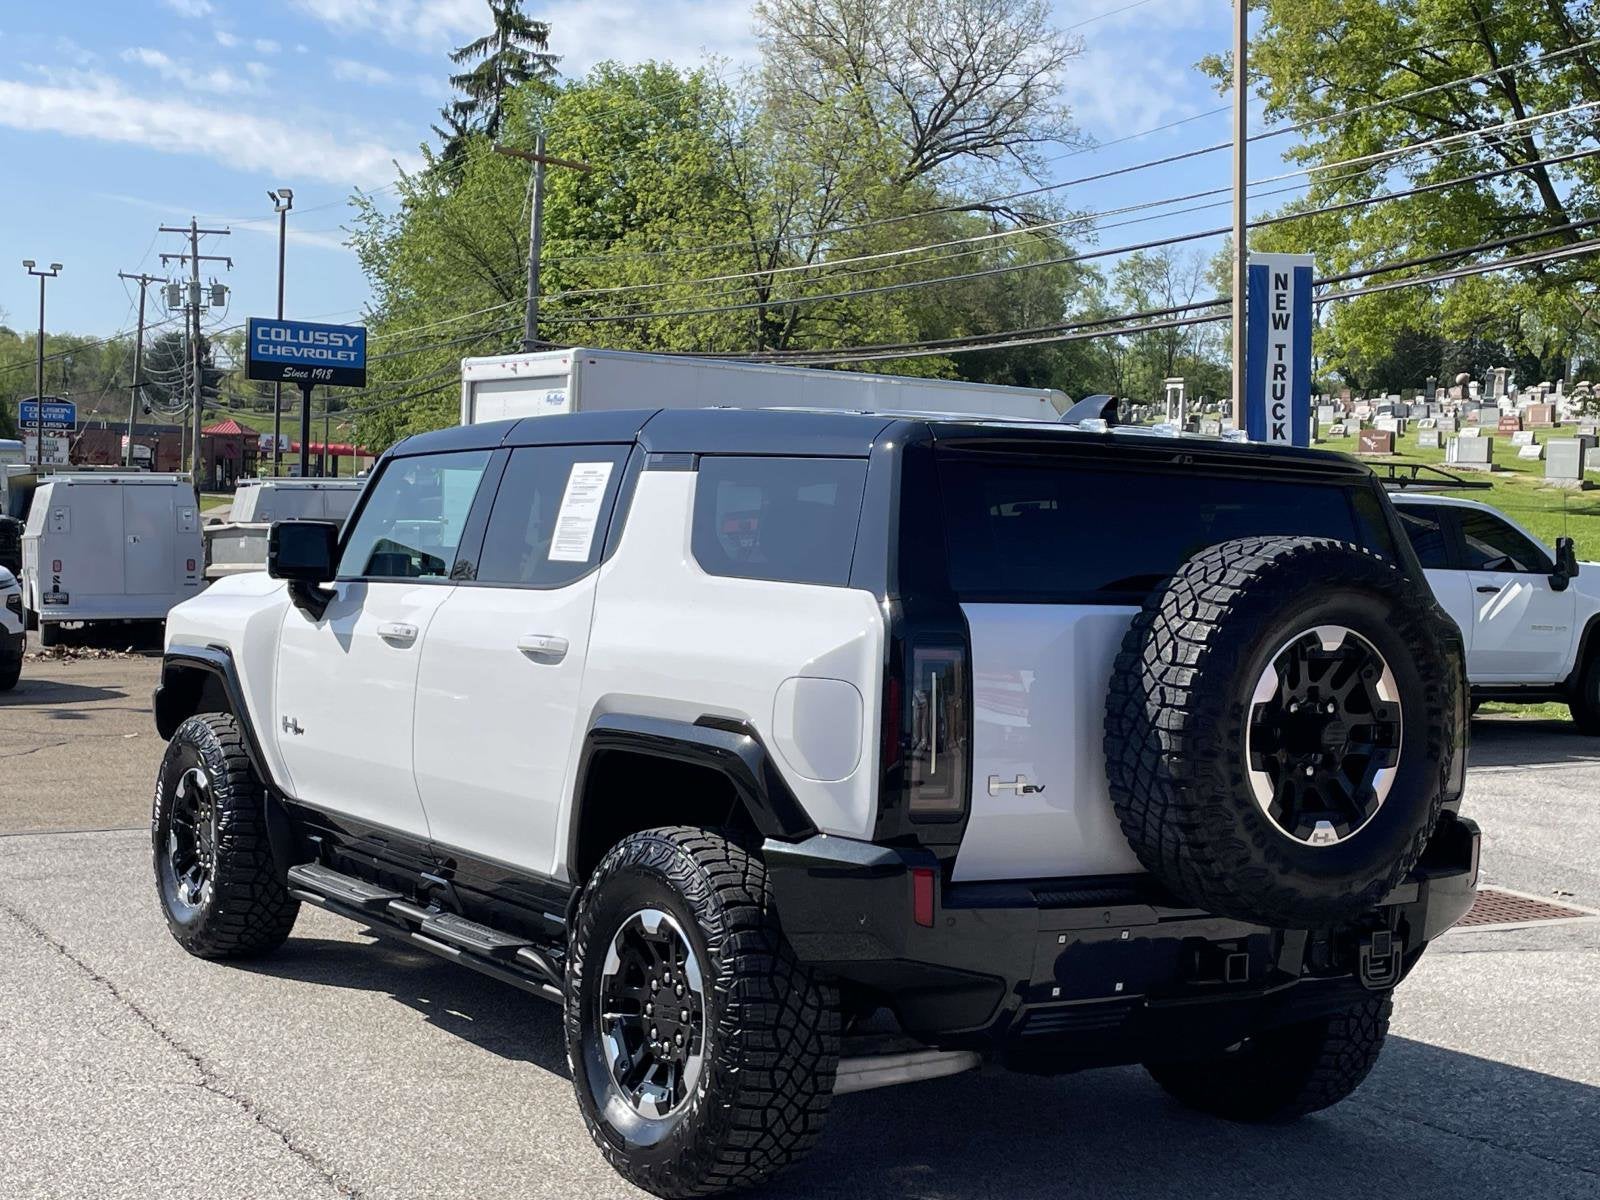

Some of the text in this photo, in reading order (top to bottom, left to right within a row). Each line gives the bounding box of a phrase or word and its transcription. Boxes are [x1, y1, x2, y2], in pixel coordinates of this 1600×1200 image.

[257, 327, 359, 348] COLUSSY
[258, 344, 358, 361] CHEVROLET
[1272, 273, 1290, 441] NEW TRUCK
[282, 367, 334, 380] Since 1918
